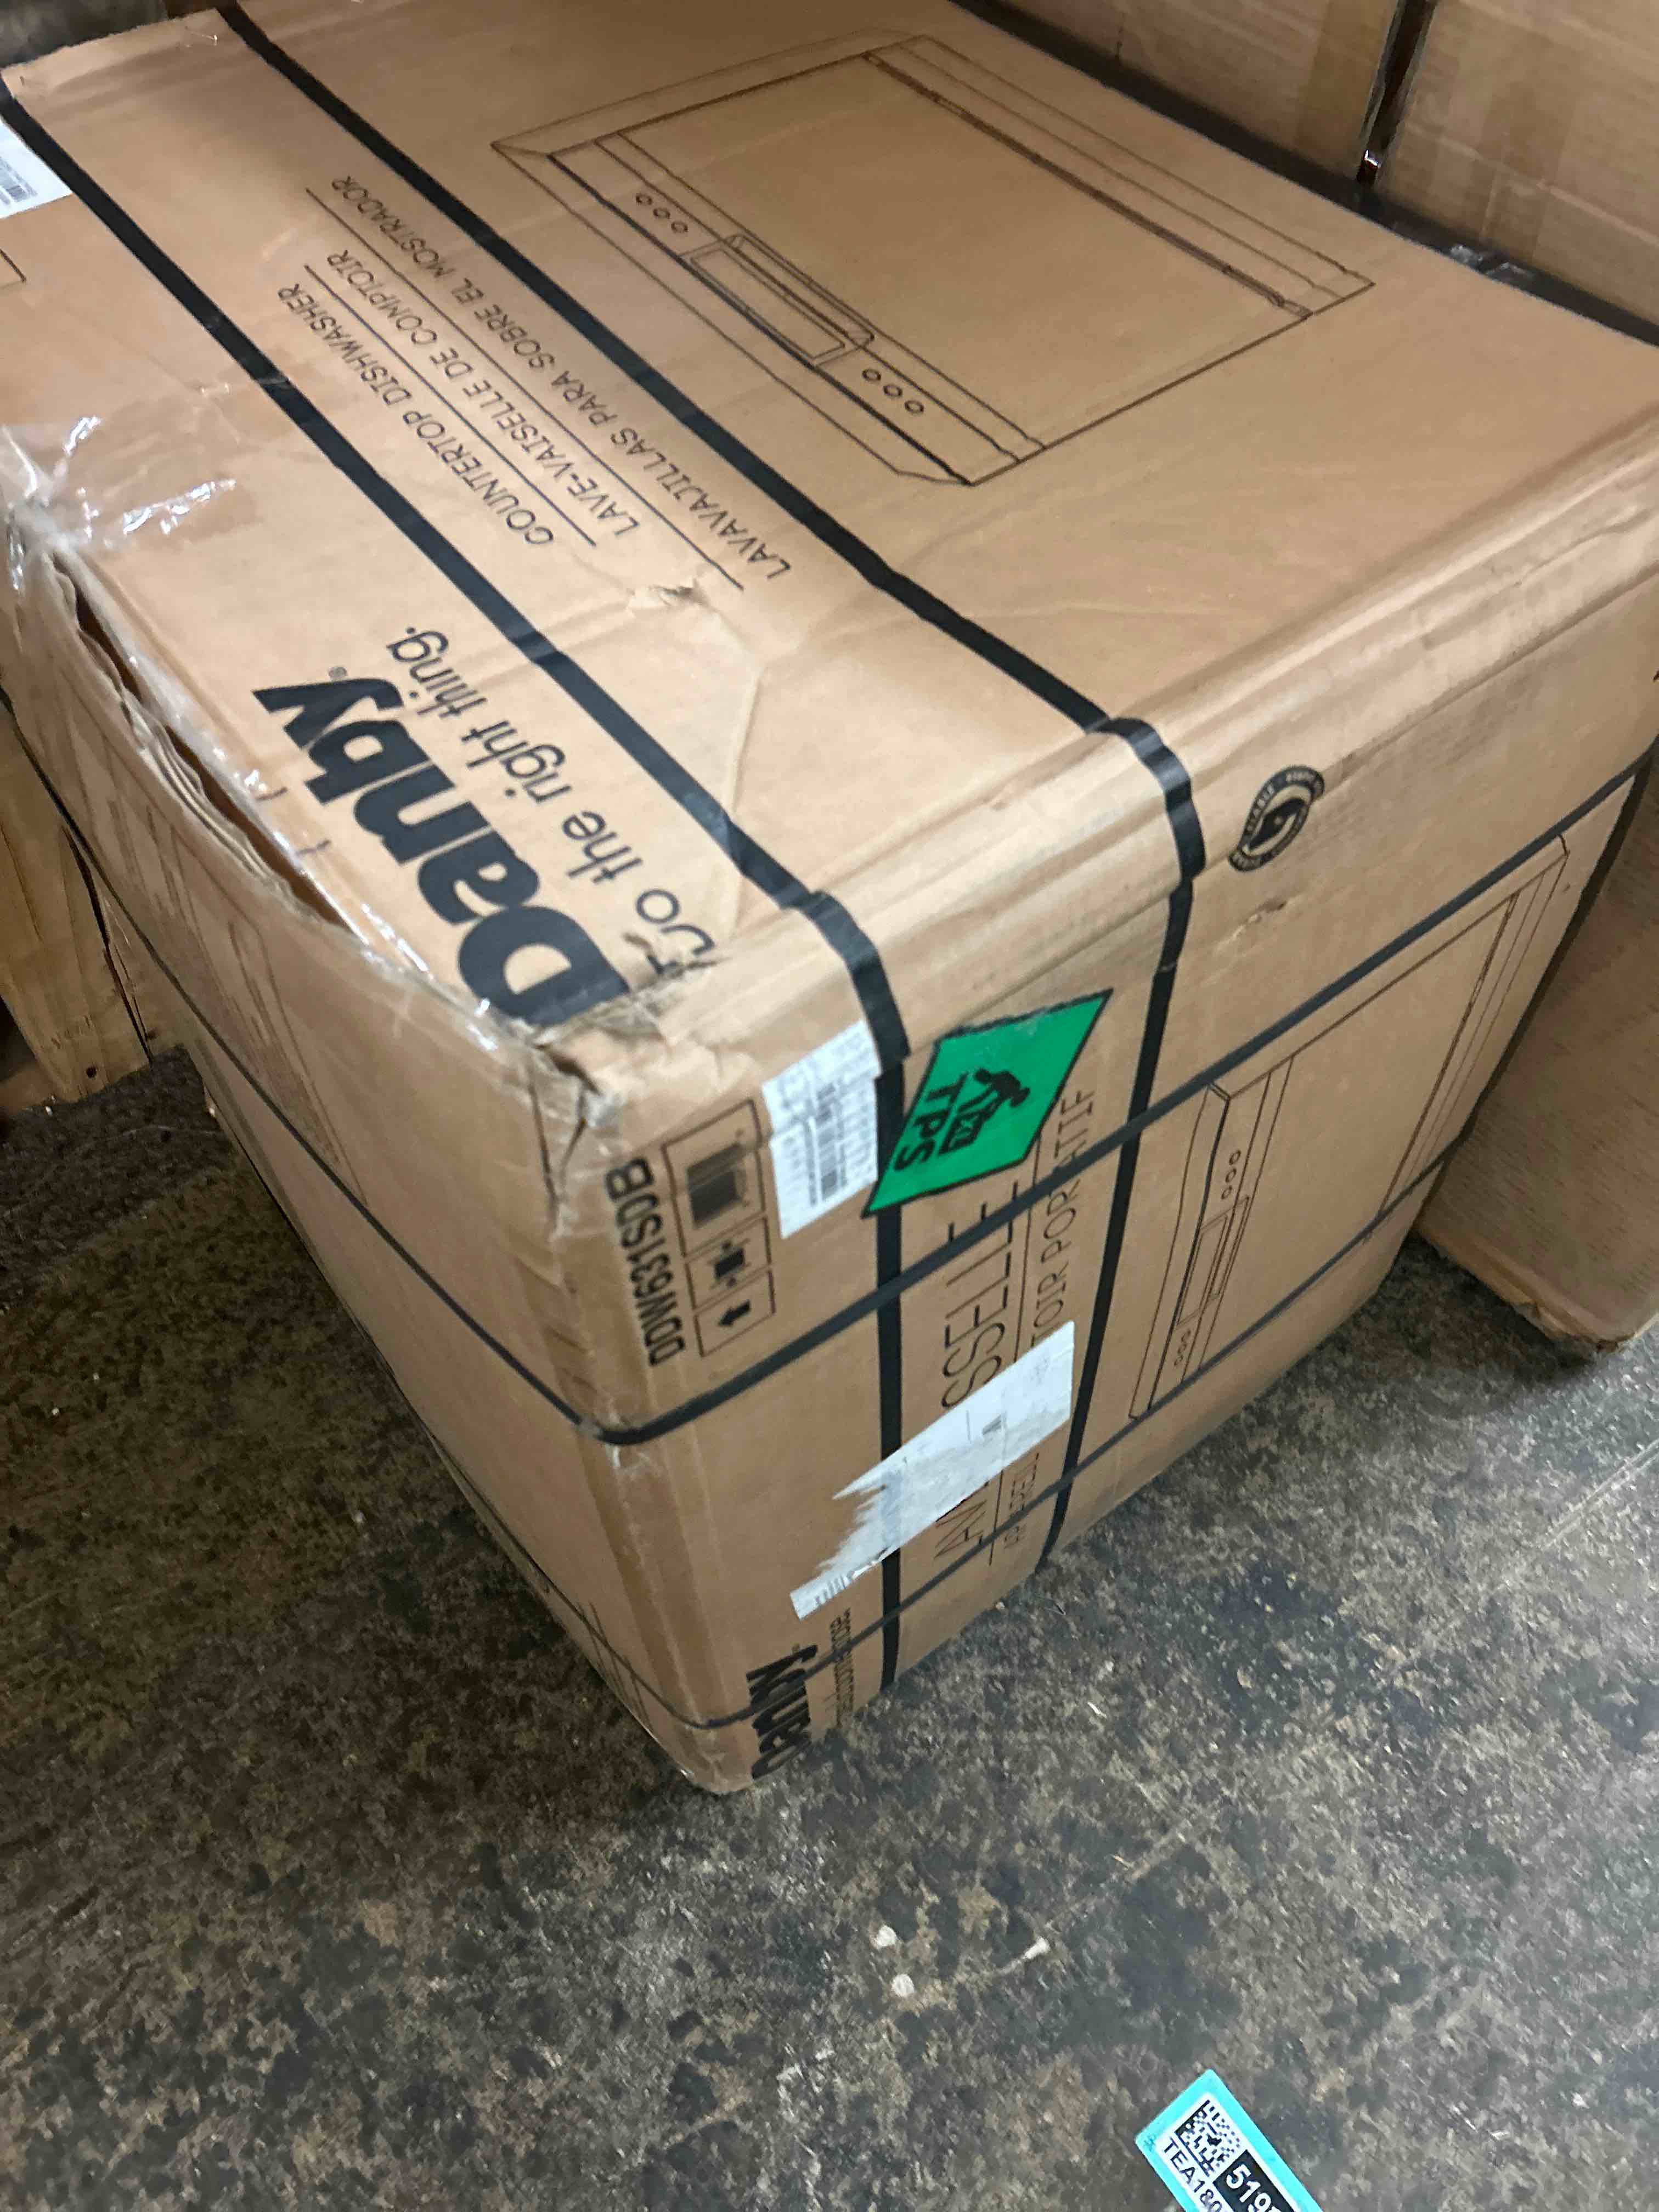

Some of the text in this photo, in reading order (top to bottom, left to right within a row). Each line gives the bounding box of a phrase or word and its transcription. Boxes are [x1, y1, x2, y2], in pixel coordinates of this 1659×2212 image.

[326, 250, 438, 345] COMPTOIR
[330, 175, 792, 580] LAVAVAJILLAS PARA SOBRE EL MOSTRADOR
[428, 347, 473, 381] DE
[277, 282, 554, 547] COUNTERTOP DISHWASHER
[386, 627, 489, 719] thing.
[460, 719, 572, 804] right
[252, 678, 630, 1025] Danby
[561, 811, 644, 884] the
[606, 1156, 686, 1367] DDW631SDB
[1226, 2163, 1284, 2211] 519
